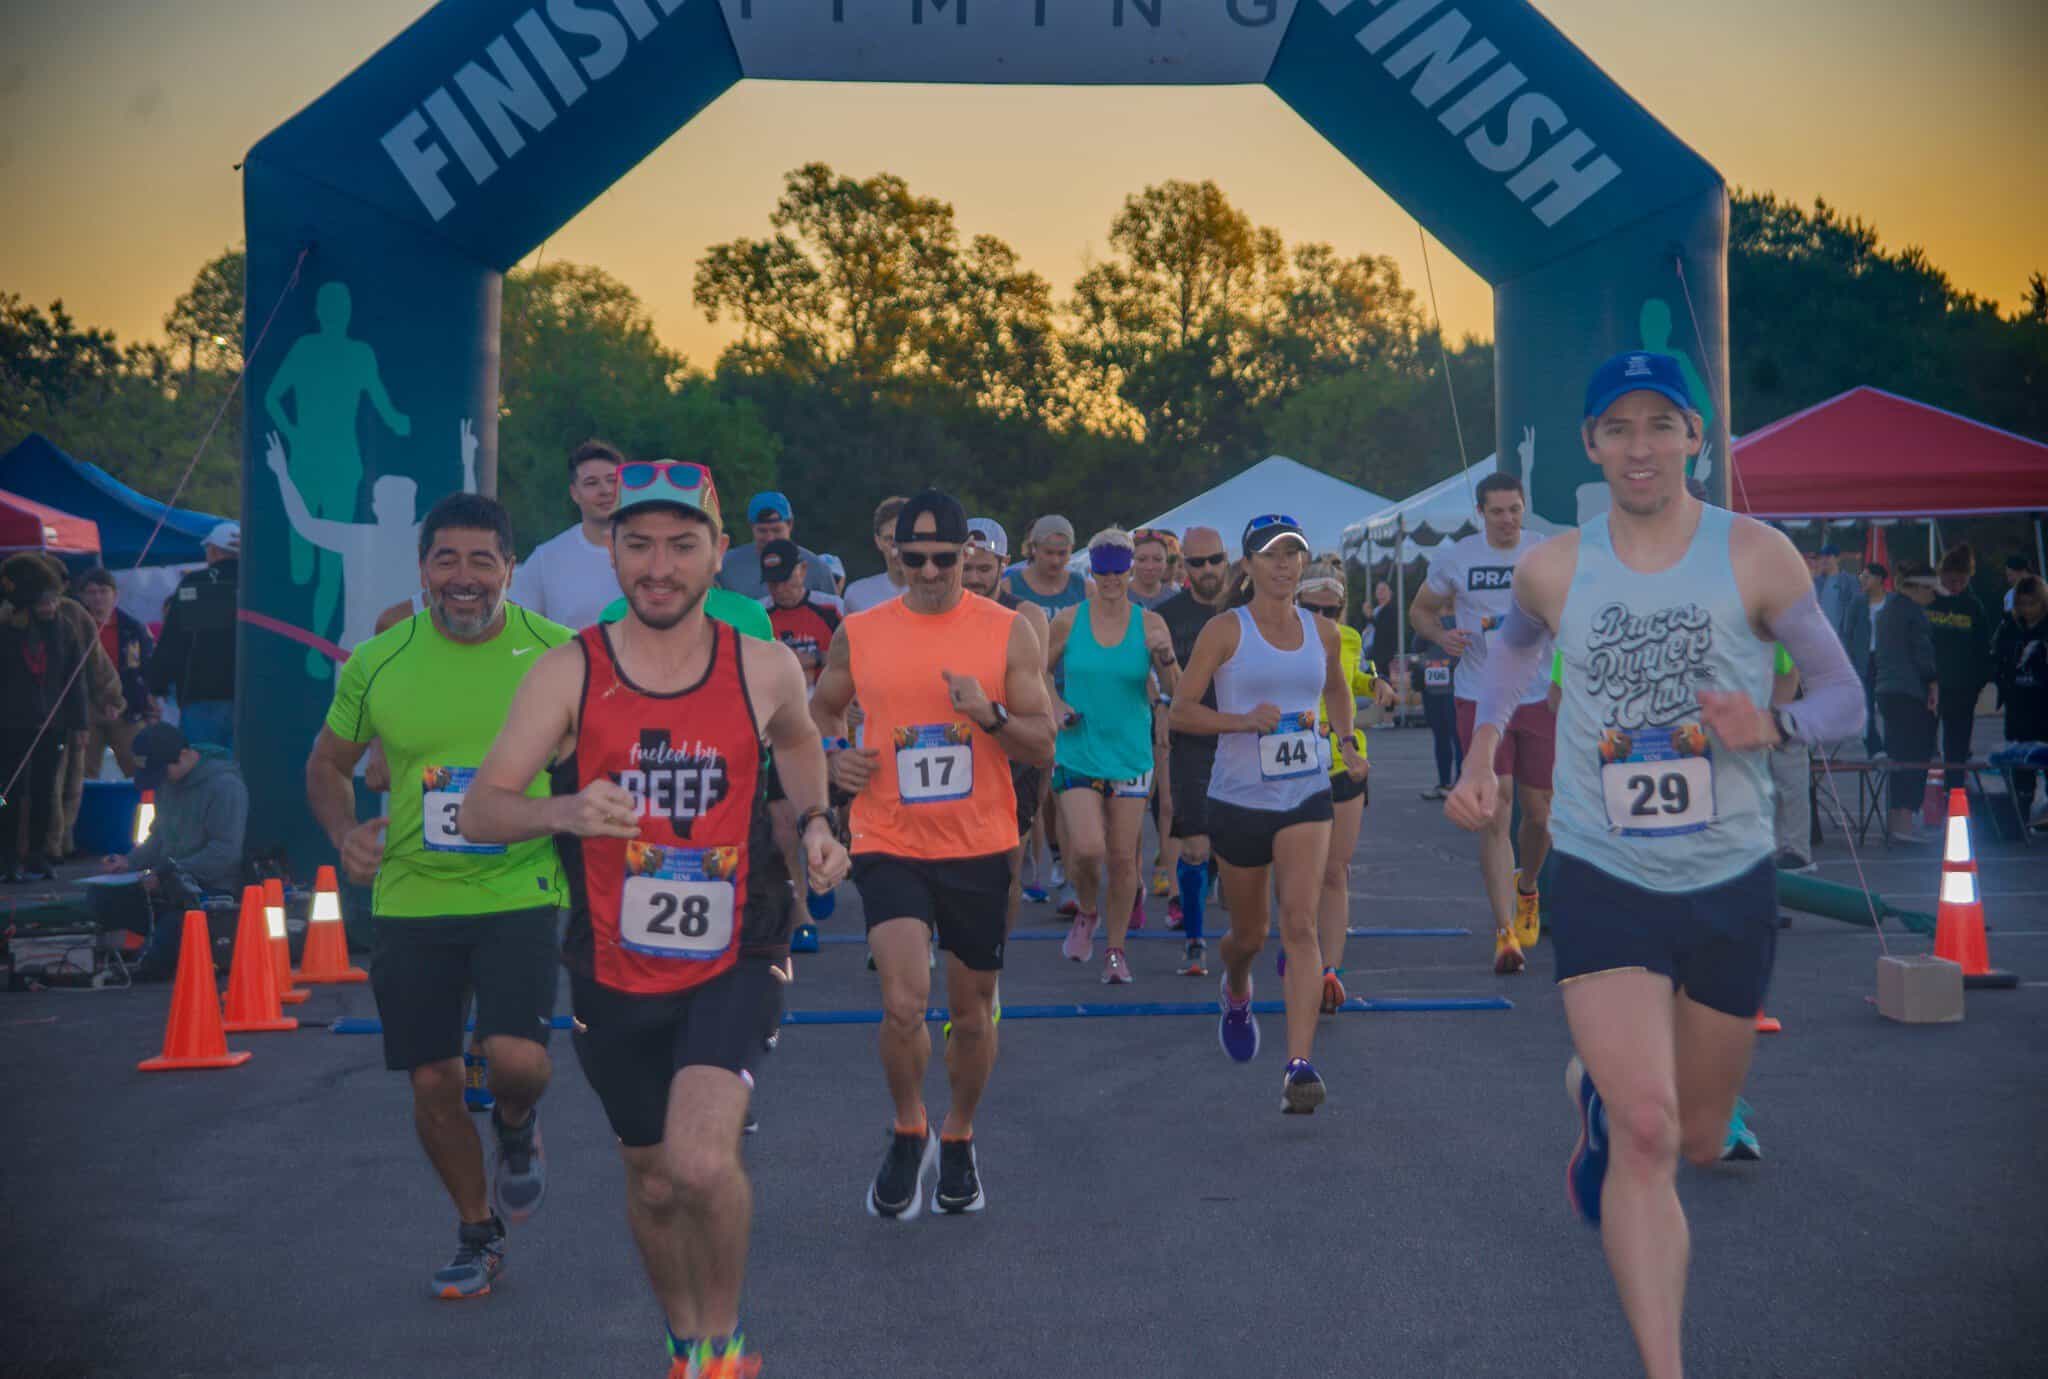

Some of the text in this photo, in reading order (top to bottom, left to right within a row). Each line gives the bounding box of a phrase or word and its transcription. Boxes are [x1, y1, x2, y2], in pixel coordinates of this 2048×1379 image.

[1318, 0, 1623, 227] INISH
[629, 740, 718, 769] fueled by
[914, 756, 955, 788] 17
[1275, 738, 1307, 766] 44
[620, 769, 722, 817] BEEF
[1627, 772, 1689, 816] 29
[646, 892, 710, 937] 28
